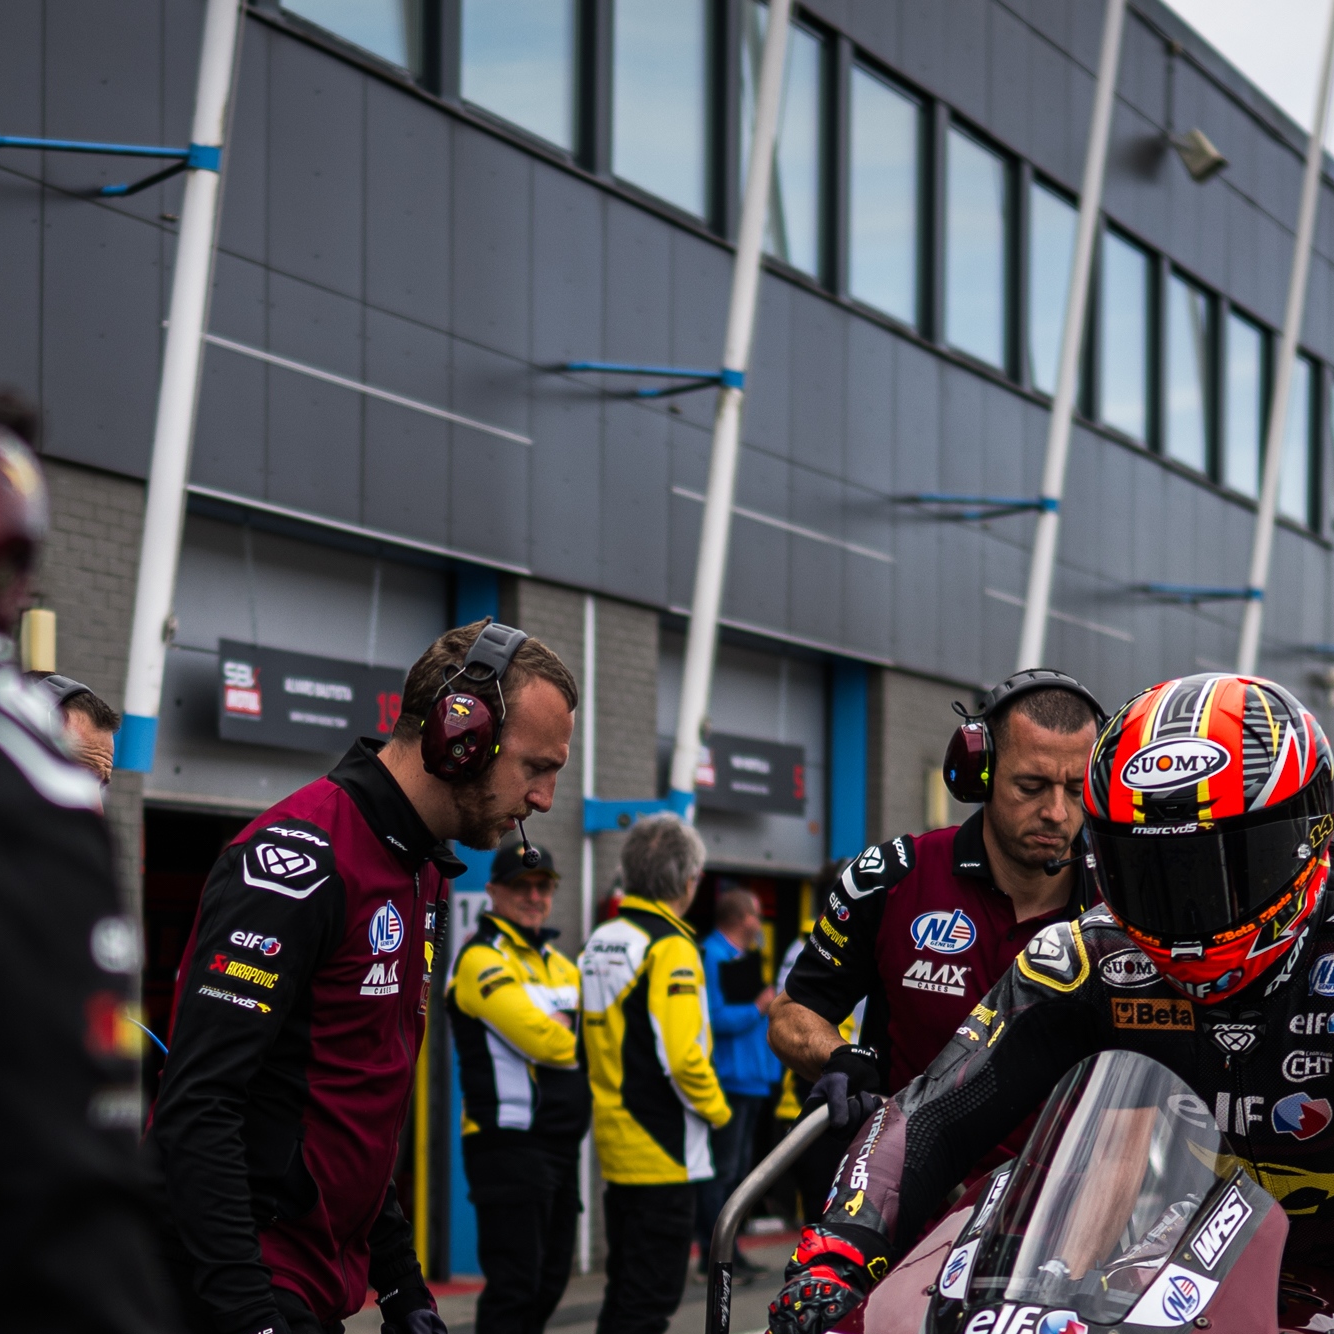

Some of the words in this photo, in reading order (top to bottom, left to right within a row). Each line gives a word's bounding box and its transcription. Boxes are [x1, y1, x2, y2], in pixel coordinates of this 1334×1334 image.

[1129, 754, 1218, 776] SUOMY
[266, 826, 330, 847] IXON
[892, 837, 909, 868] XON
[829, 892, 843, 911] elf
[230, 931, 264, 949] elf
[930, 941, 956, 949] GENEVA
[362, 959, 400, 985] MAX
[903, 959, 968, 987] MAX
[1105, 957, 1155, 976] SUOM
[917, 982, 949, 993] CASES
[1136, 1002, 1193, 1026] Beta
[1289, 1013, 1328, 1035] elf
[1213, 1023, 1257, 1031] IXON
[1167, 1091, 1266, 1133] elf
[1194, 1192, 1244, 1265] WRS
